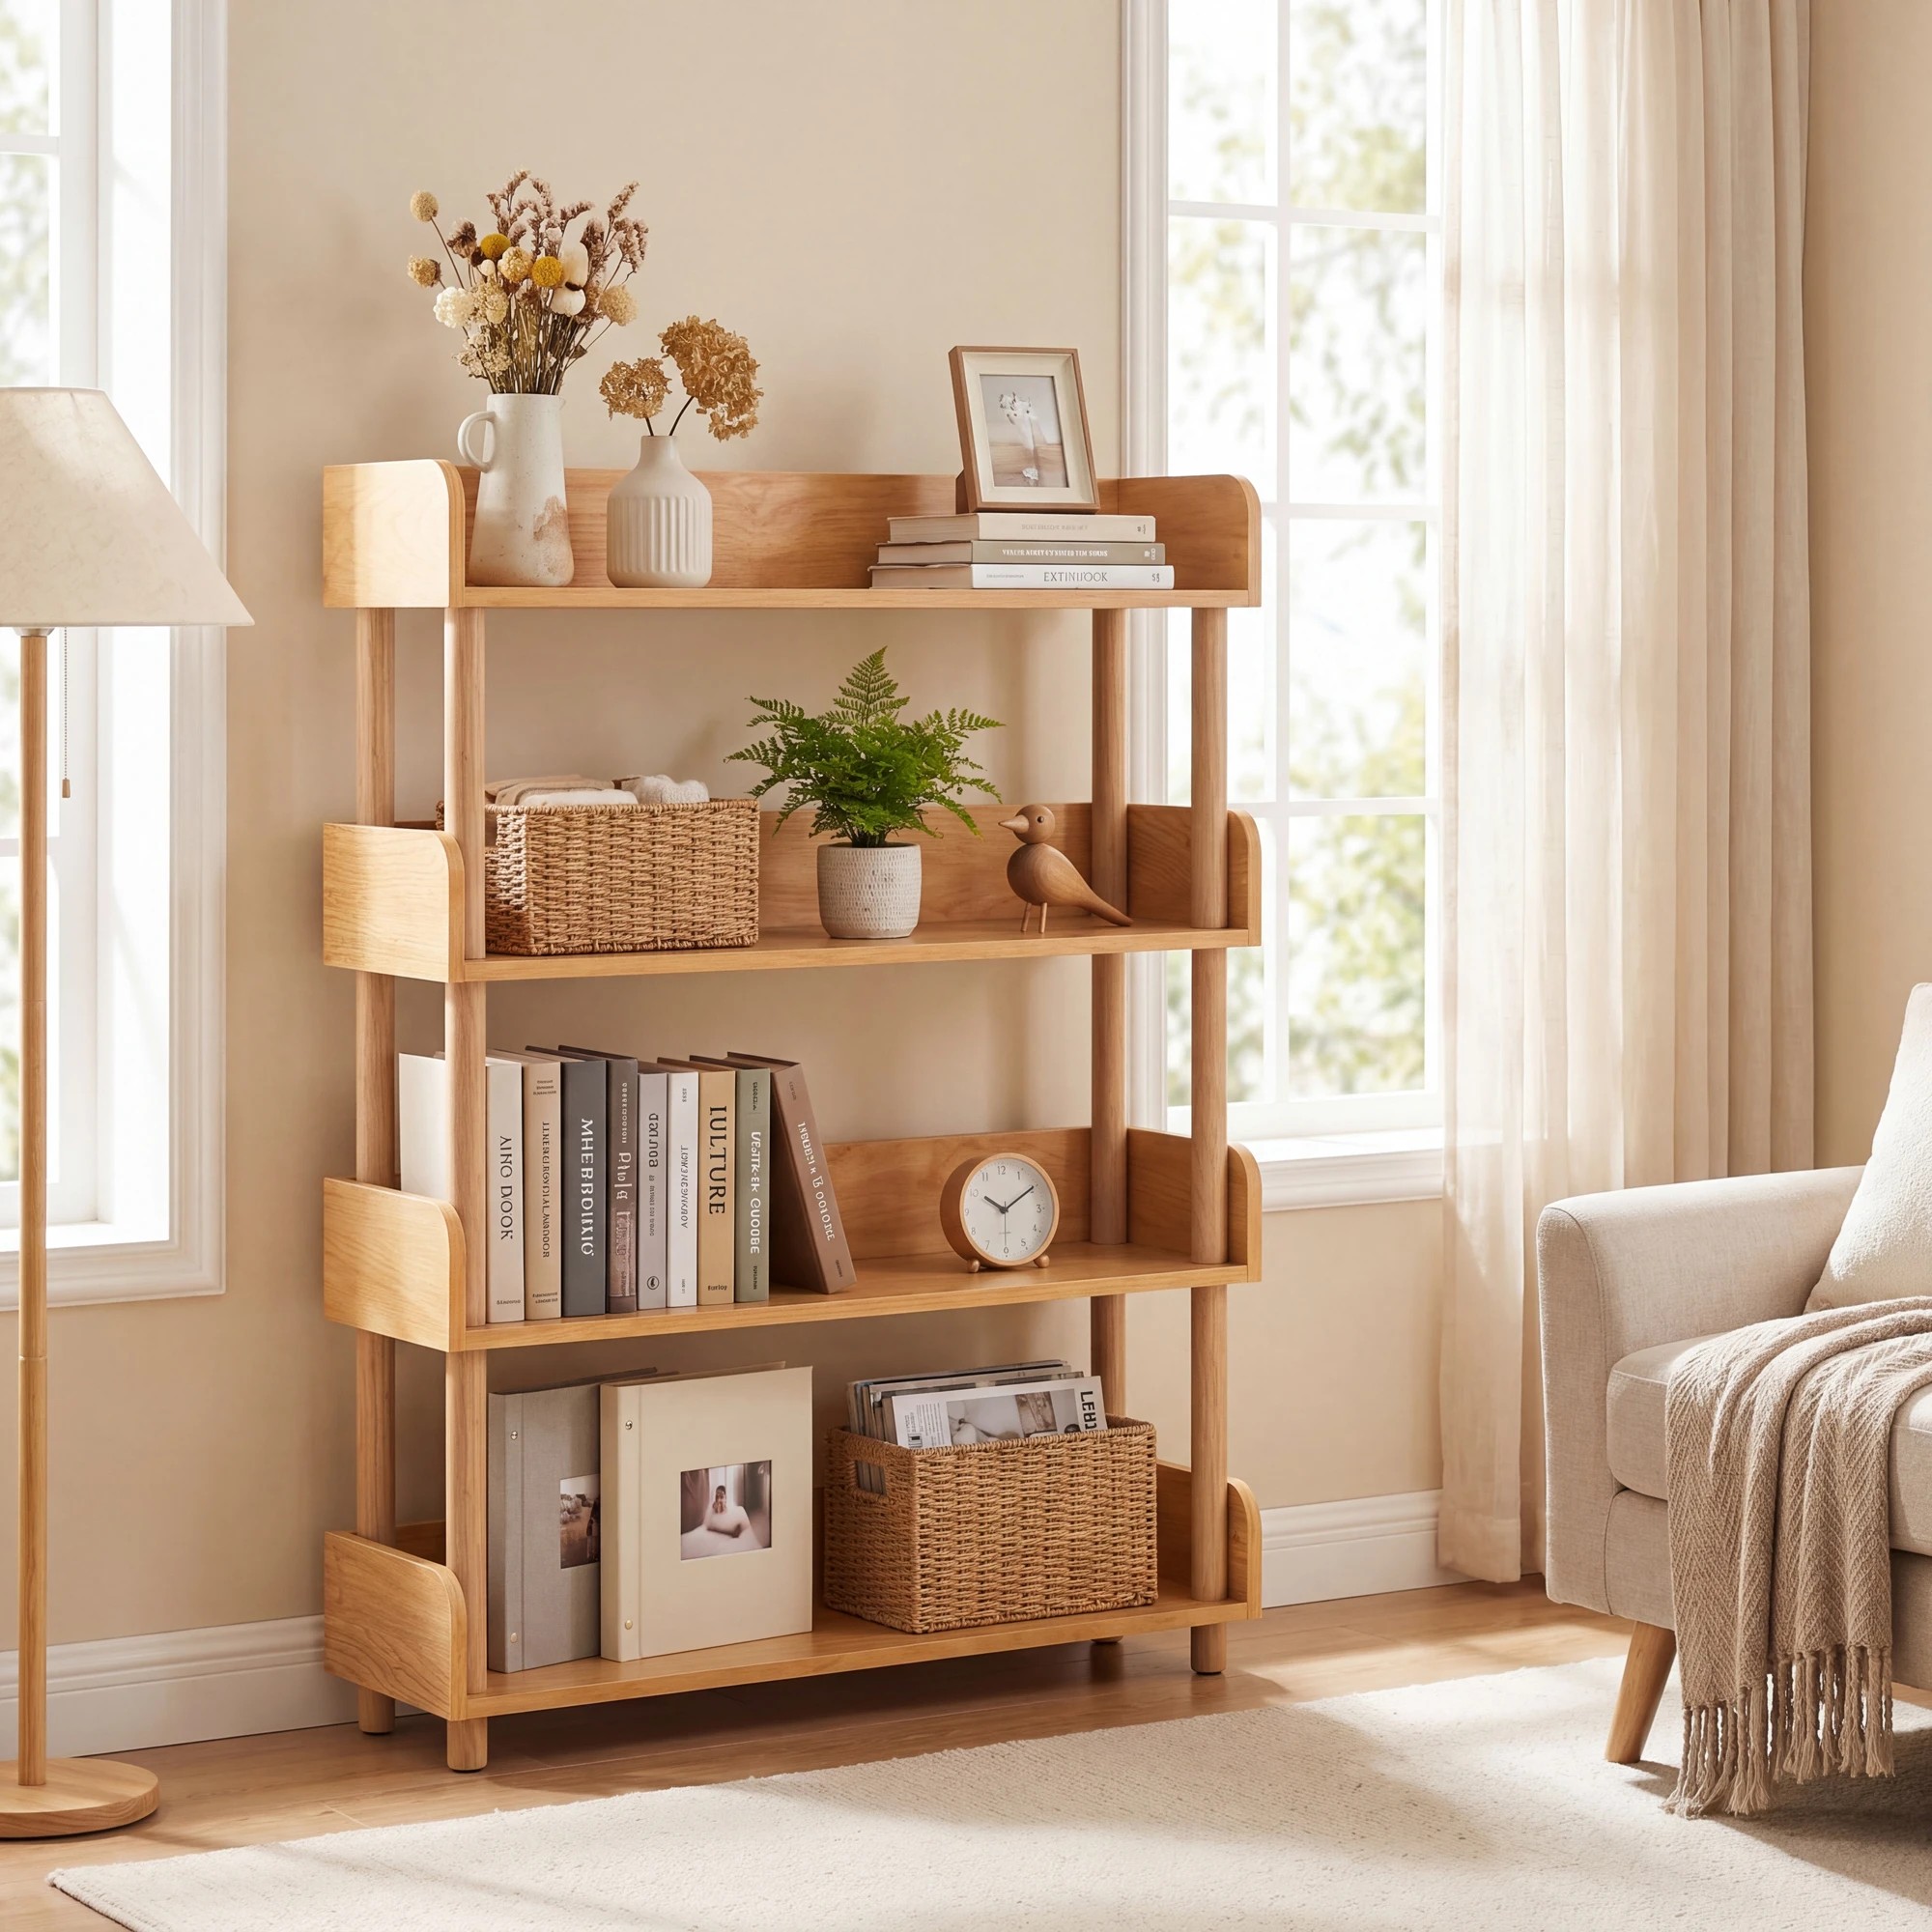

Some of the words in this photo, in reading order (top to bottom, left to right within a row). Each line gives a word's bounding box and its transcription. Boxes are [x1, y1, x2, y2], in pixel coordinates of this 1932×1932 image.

[997, 1165, 1006, 1176] 12
[981, 1172, 989, 1182] 11
[1037, 1204, 1042, 1213] 3
[971, 1227, 977, 1236] 8
[985, 1240, 990, 1251] 7
[1020, 1238, 1027, 1247] 5
